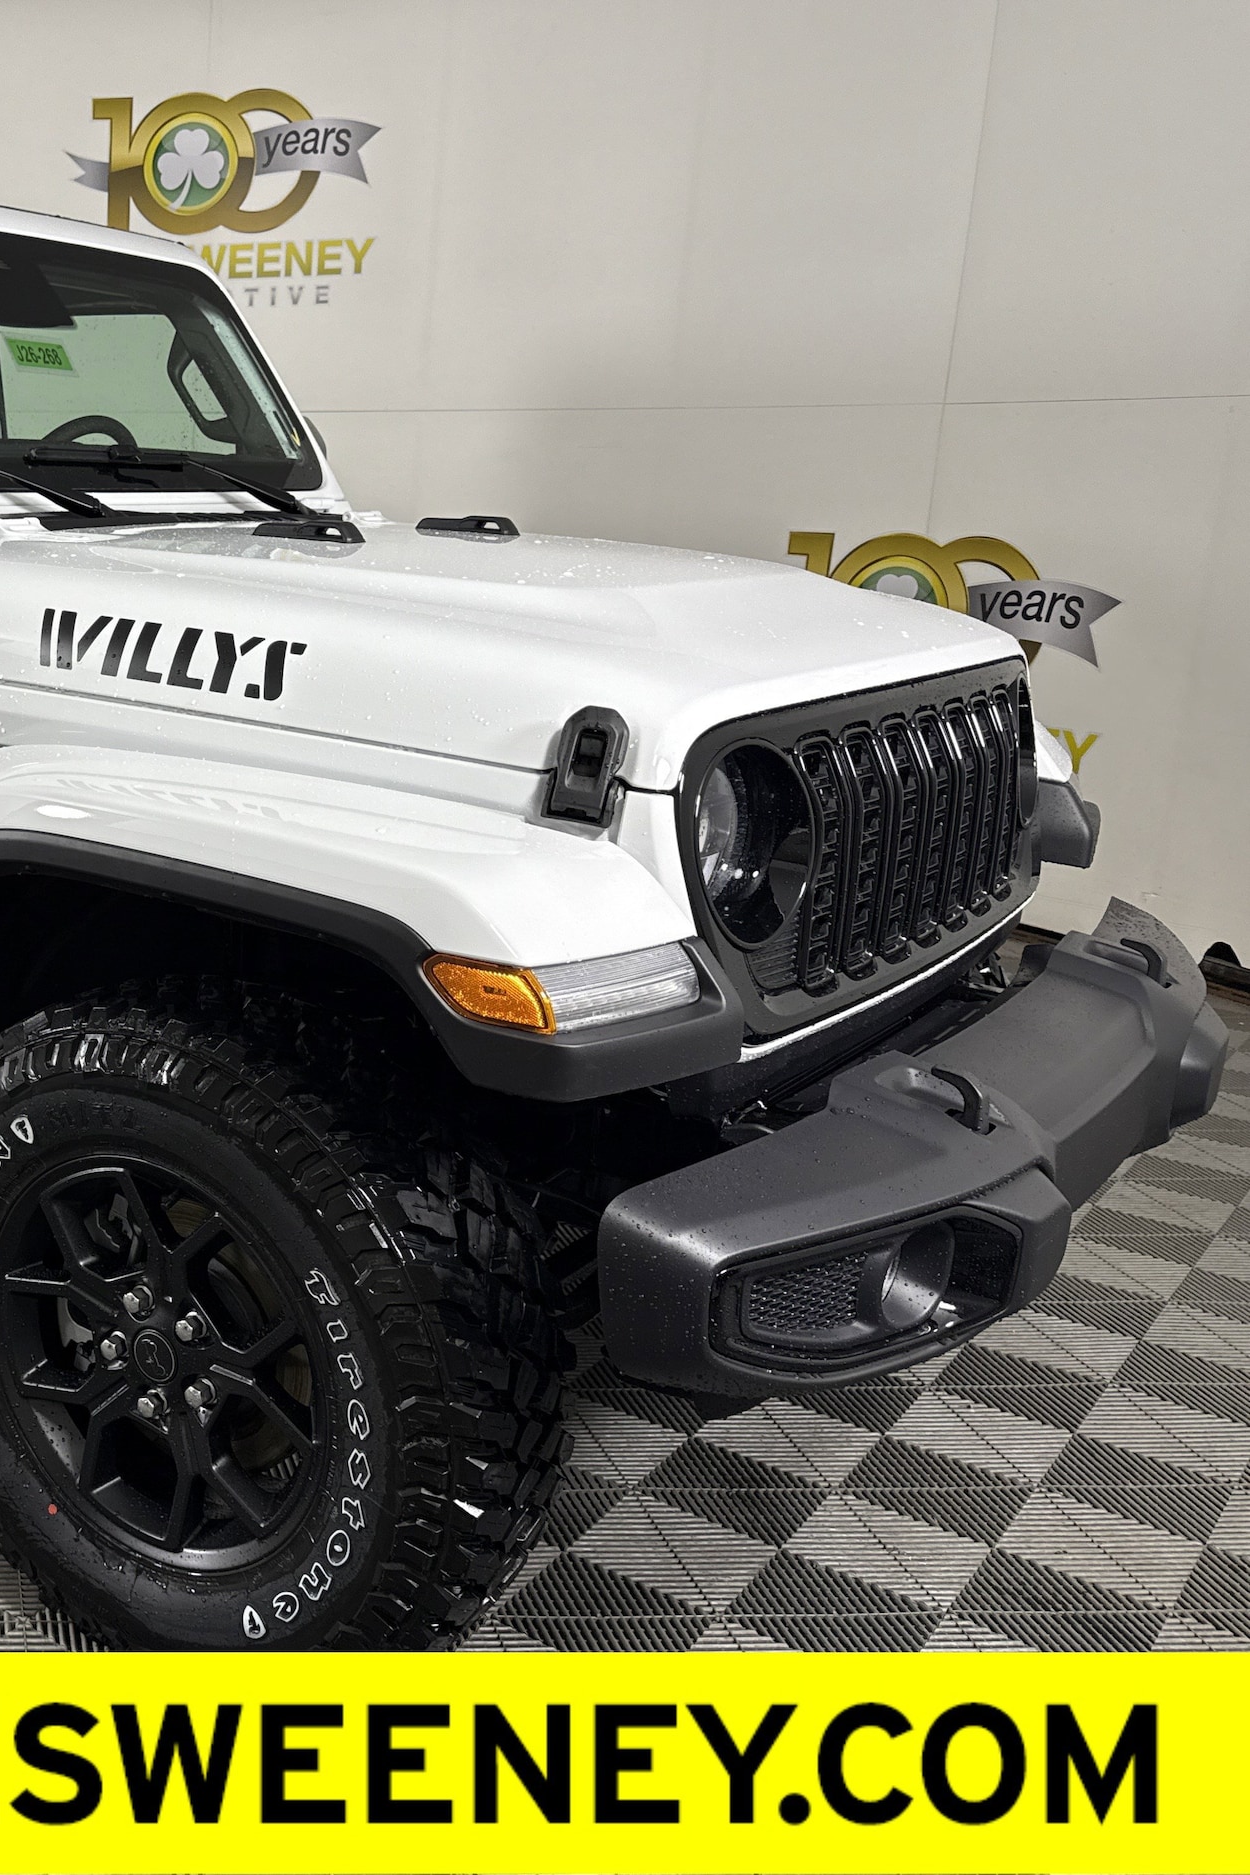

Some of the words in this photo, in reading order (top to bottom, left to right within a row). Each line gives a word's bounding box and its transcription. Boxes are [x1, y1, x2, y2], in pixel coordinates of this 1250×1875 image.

[263, 126, 352, 168] years
[228, 286, 330, 307] TIVE
[15, 344, 63, 367] J26-268
[980, 590, 1085, 630] years
[39, 608, 308, 701] WILLYS
[272, 1267, 372, 1623] Firestone
